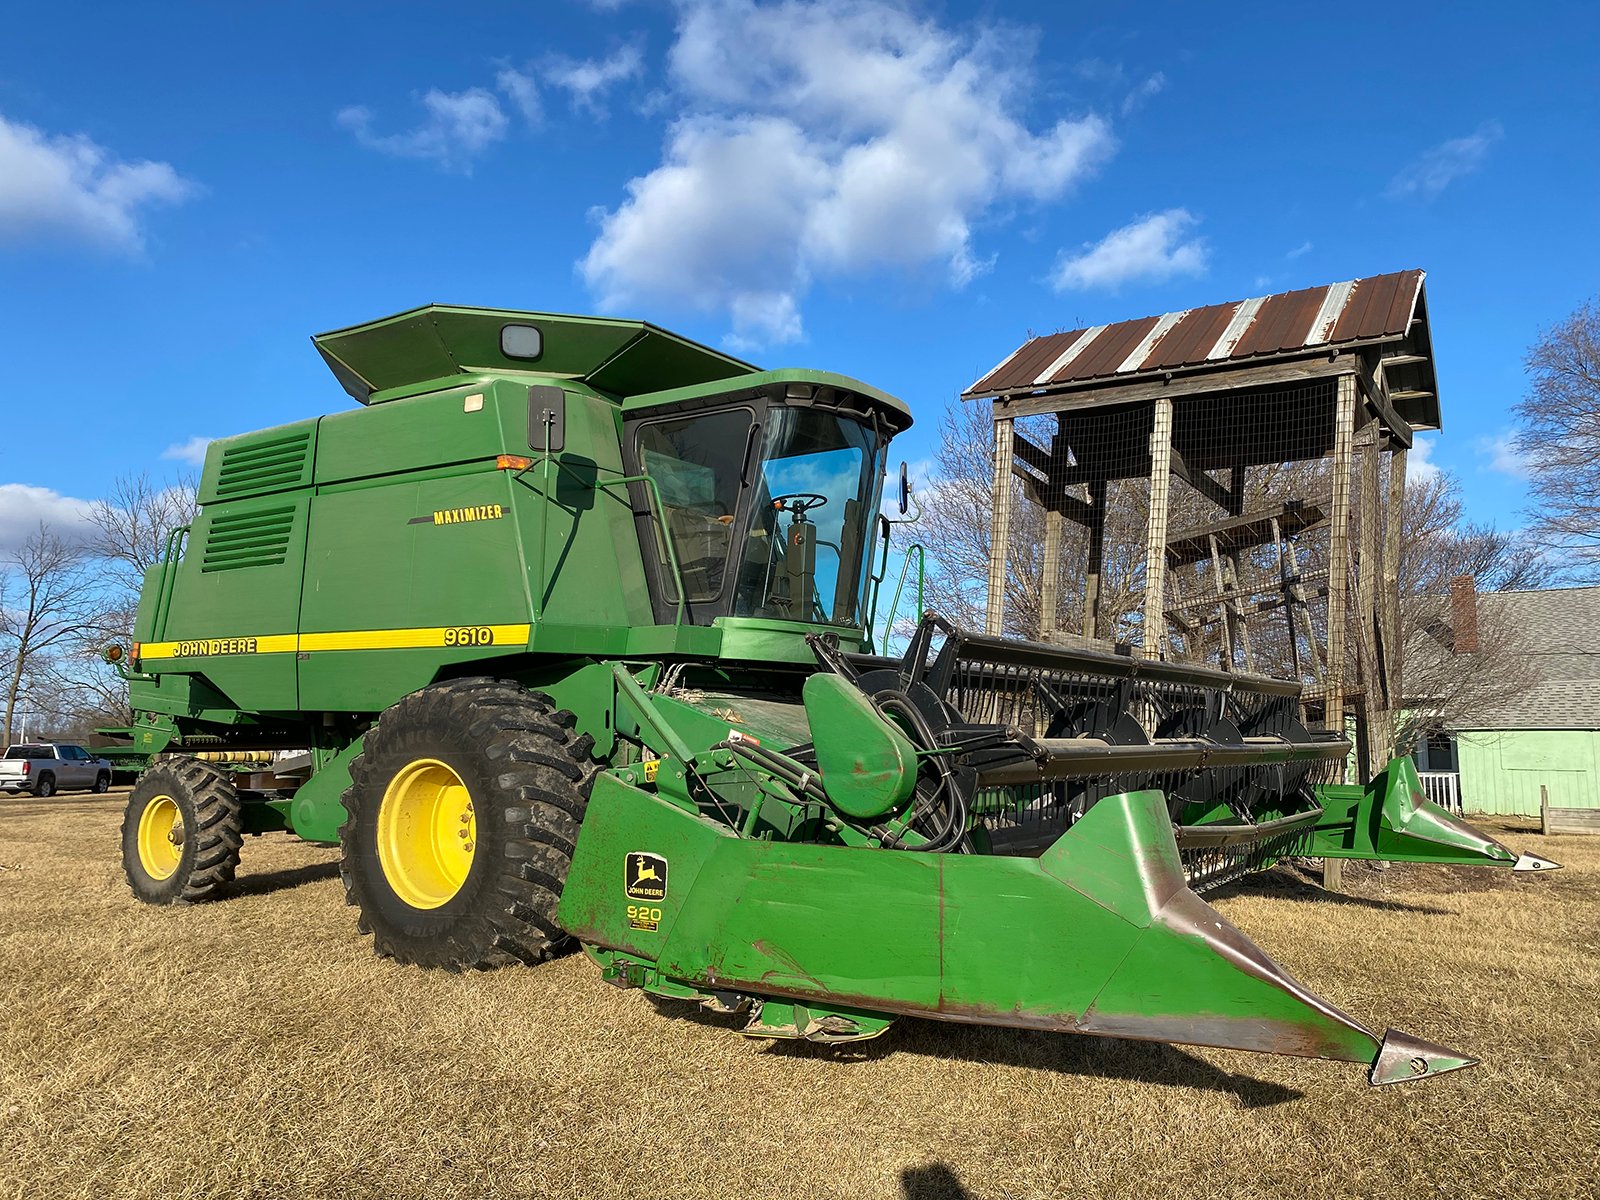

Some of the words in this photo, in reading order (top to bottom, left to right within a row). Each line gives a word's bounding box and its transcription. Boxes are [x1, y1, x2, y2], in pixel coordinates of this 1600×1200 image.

[433, 504, 503, 526] MAXIMIZER
[444, 627, 494, 646] 9610
[173, 641, 209, 657] JOHN
[211, 638, 257, 655] DEERE
[628, 886, 644, 895] JOHN
[644, 887, 664, 897] DEERE
[626, 905, 662, 921] 920
